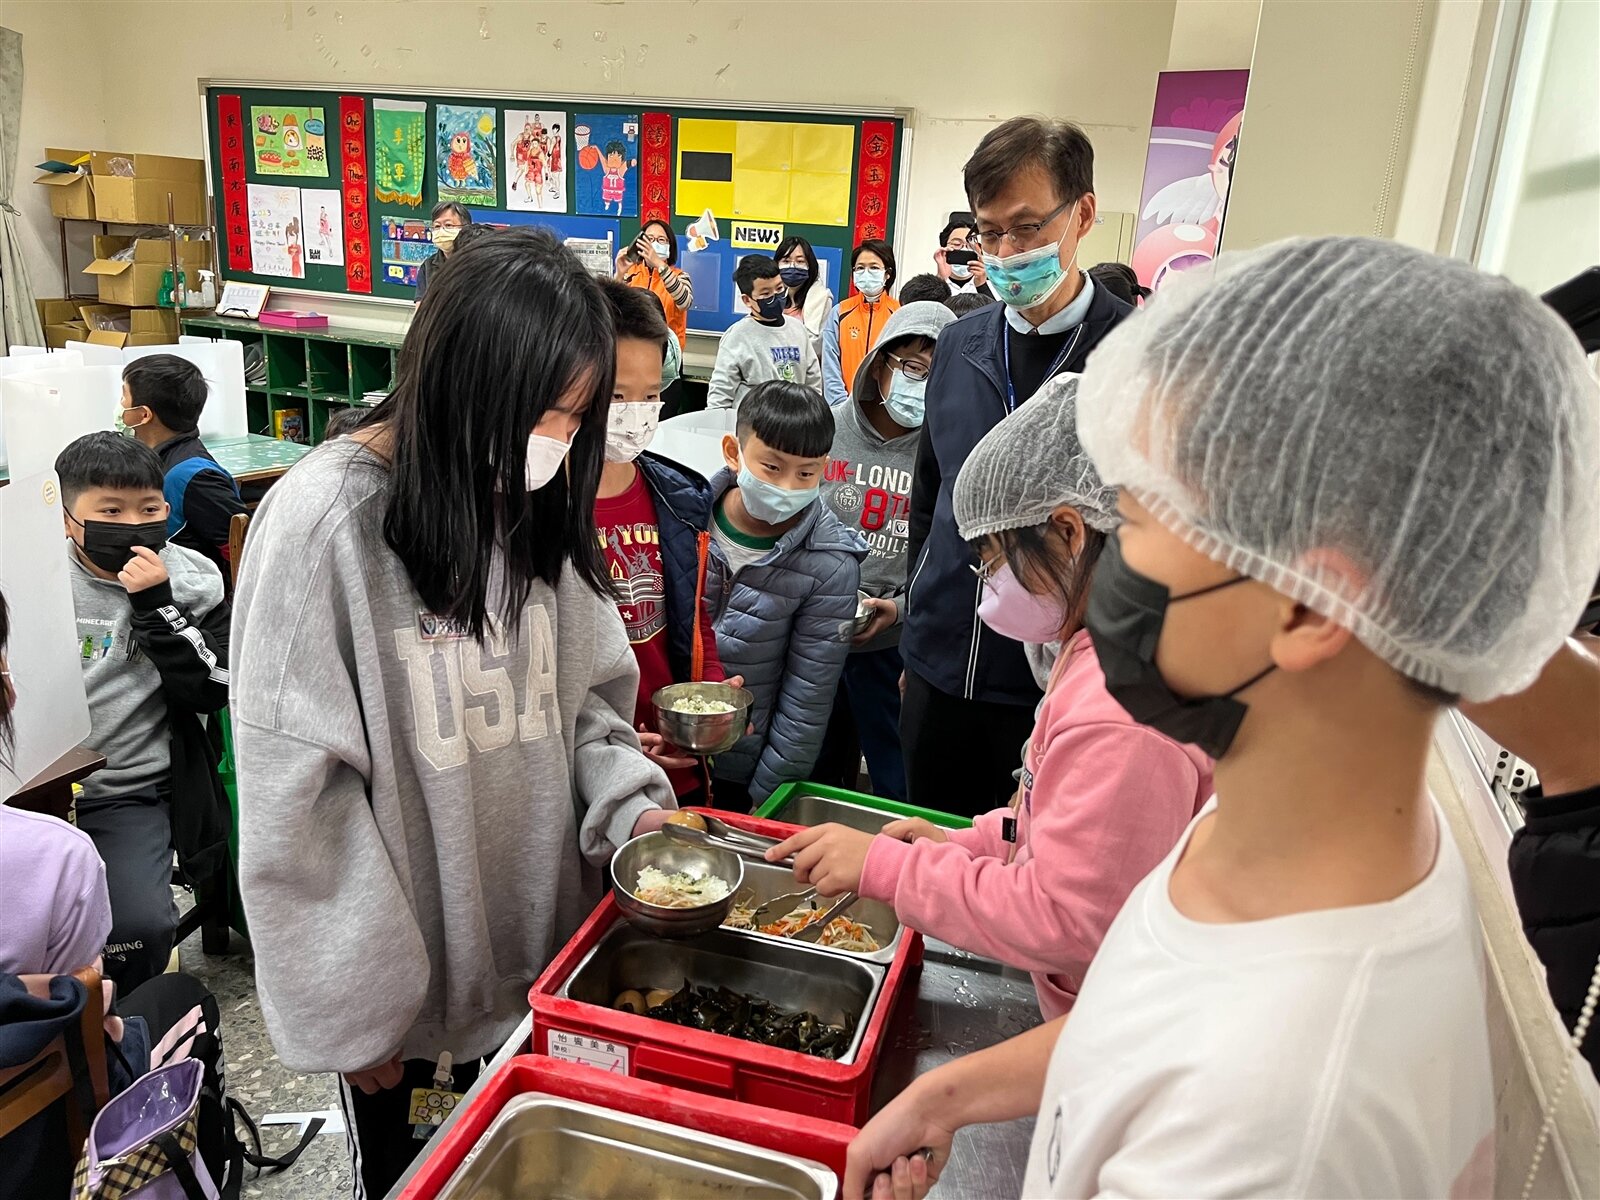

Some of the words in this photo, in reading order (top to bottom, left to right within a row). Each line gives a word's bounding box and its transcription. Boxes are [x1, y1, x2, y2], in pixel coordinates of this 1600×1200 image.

[346, 115, 359, 126] One
[351, 195, 361, 204] 旺
[735, 226, 780, 244] NEWS
[76, 617, 118, 626] MINECRAFT
[394, 604, 562, 771] USA
